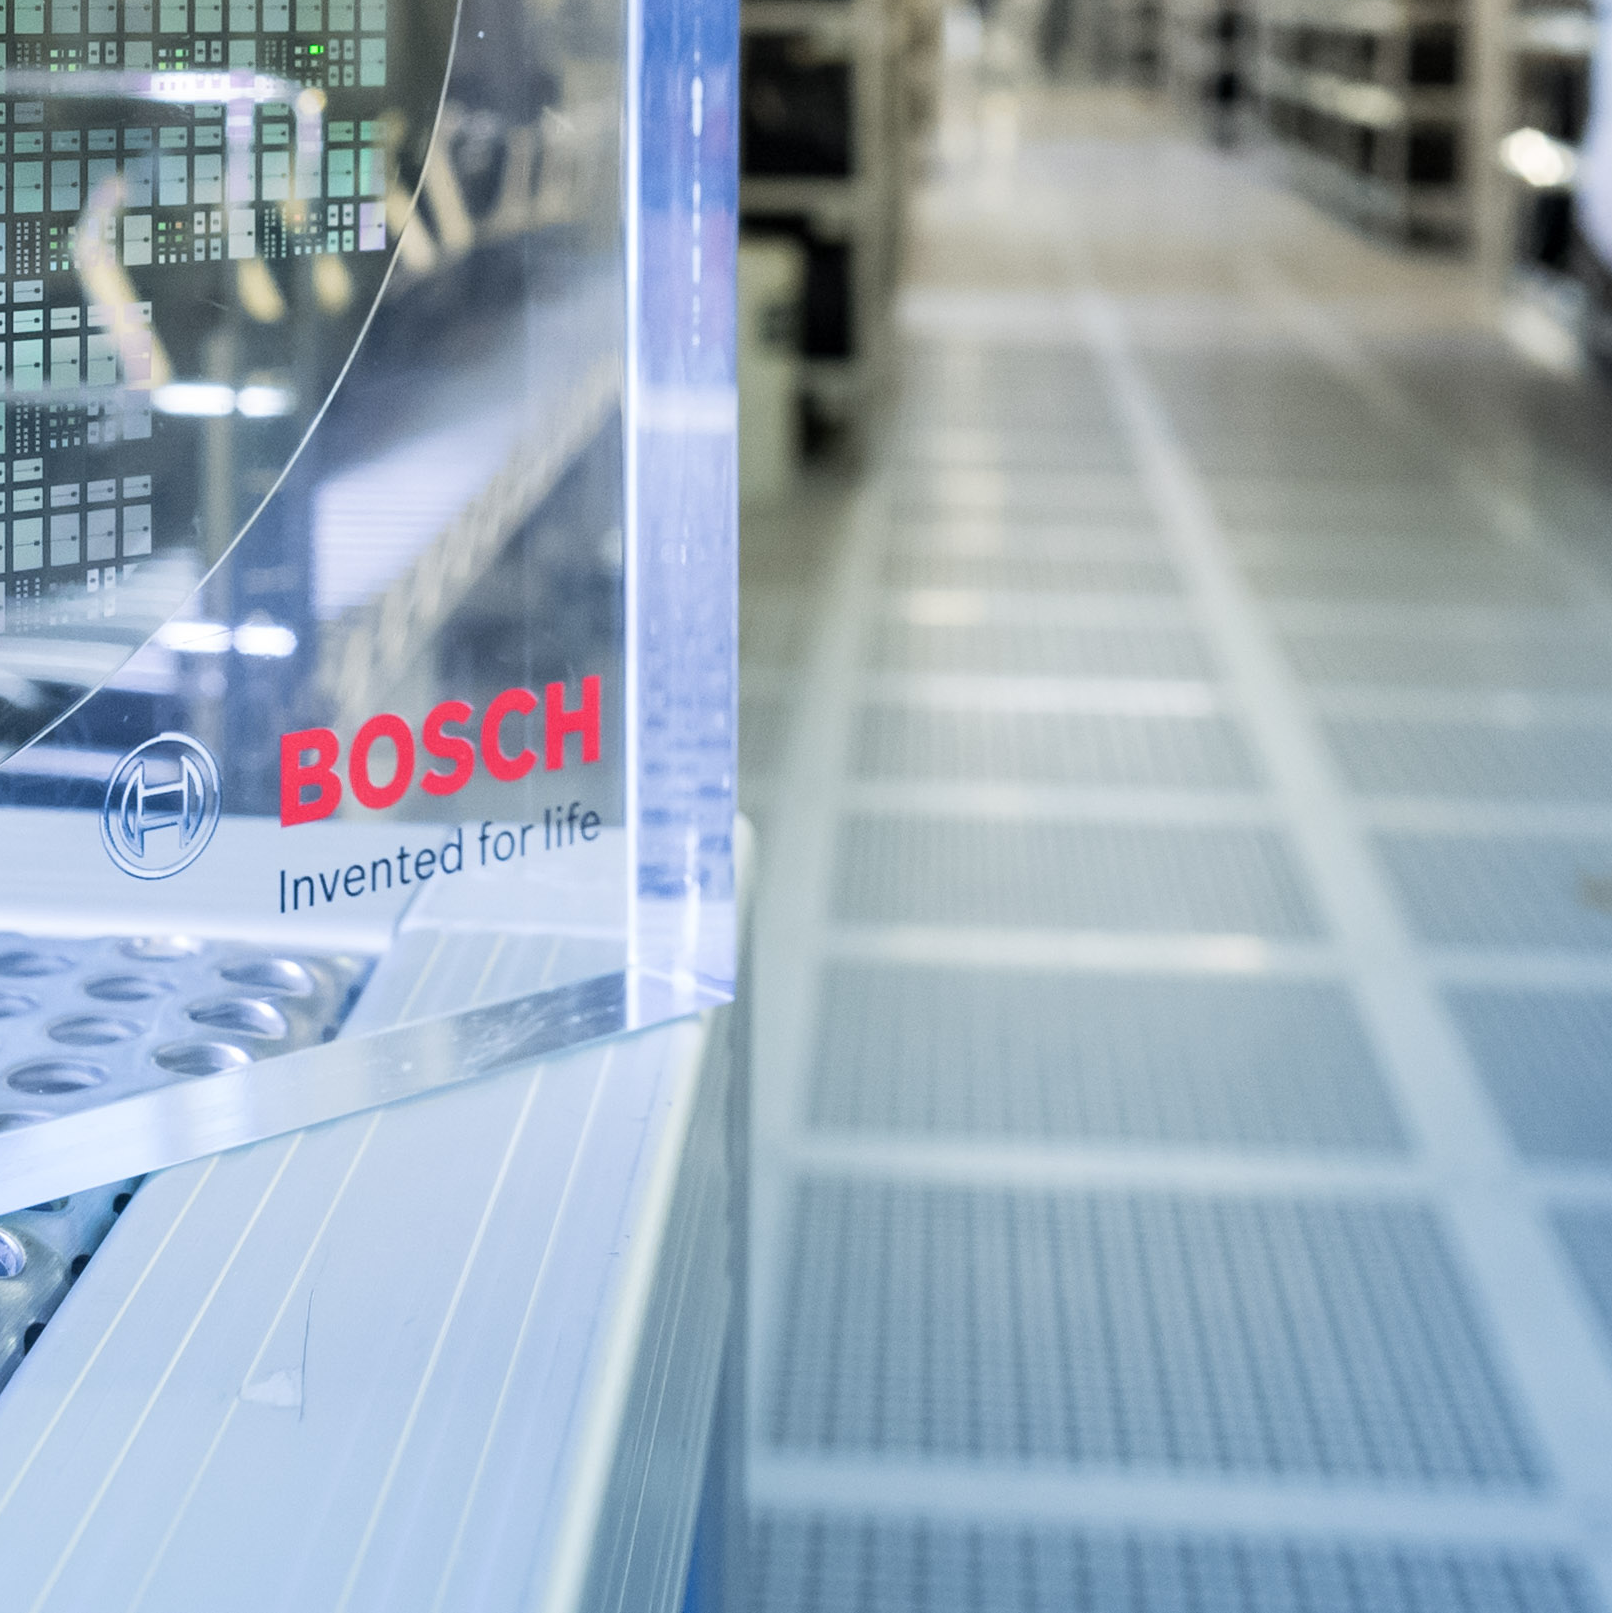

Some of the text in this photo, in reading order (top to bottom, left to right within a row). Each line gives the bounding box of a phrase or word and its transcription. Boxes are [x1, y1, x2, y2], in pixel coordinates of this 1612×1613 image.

[280, 676, 602, 828] BOSCH
[280, 801, 603, 914] Invented for life
